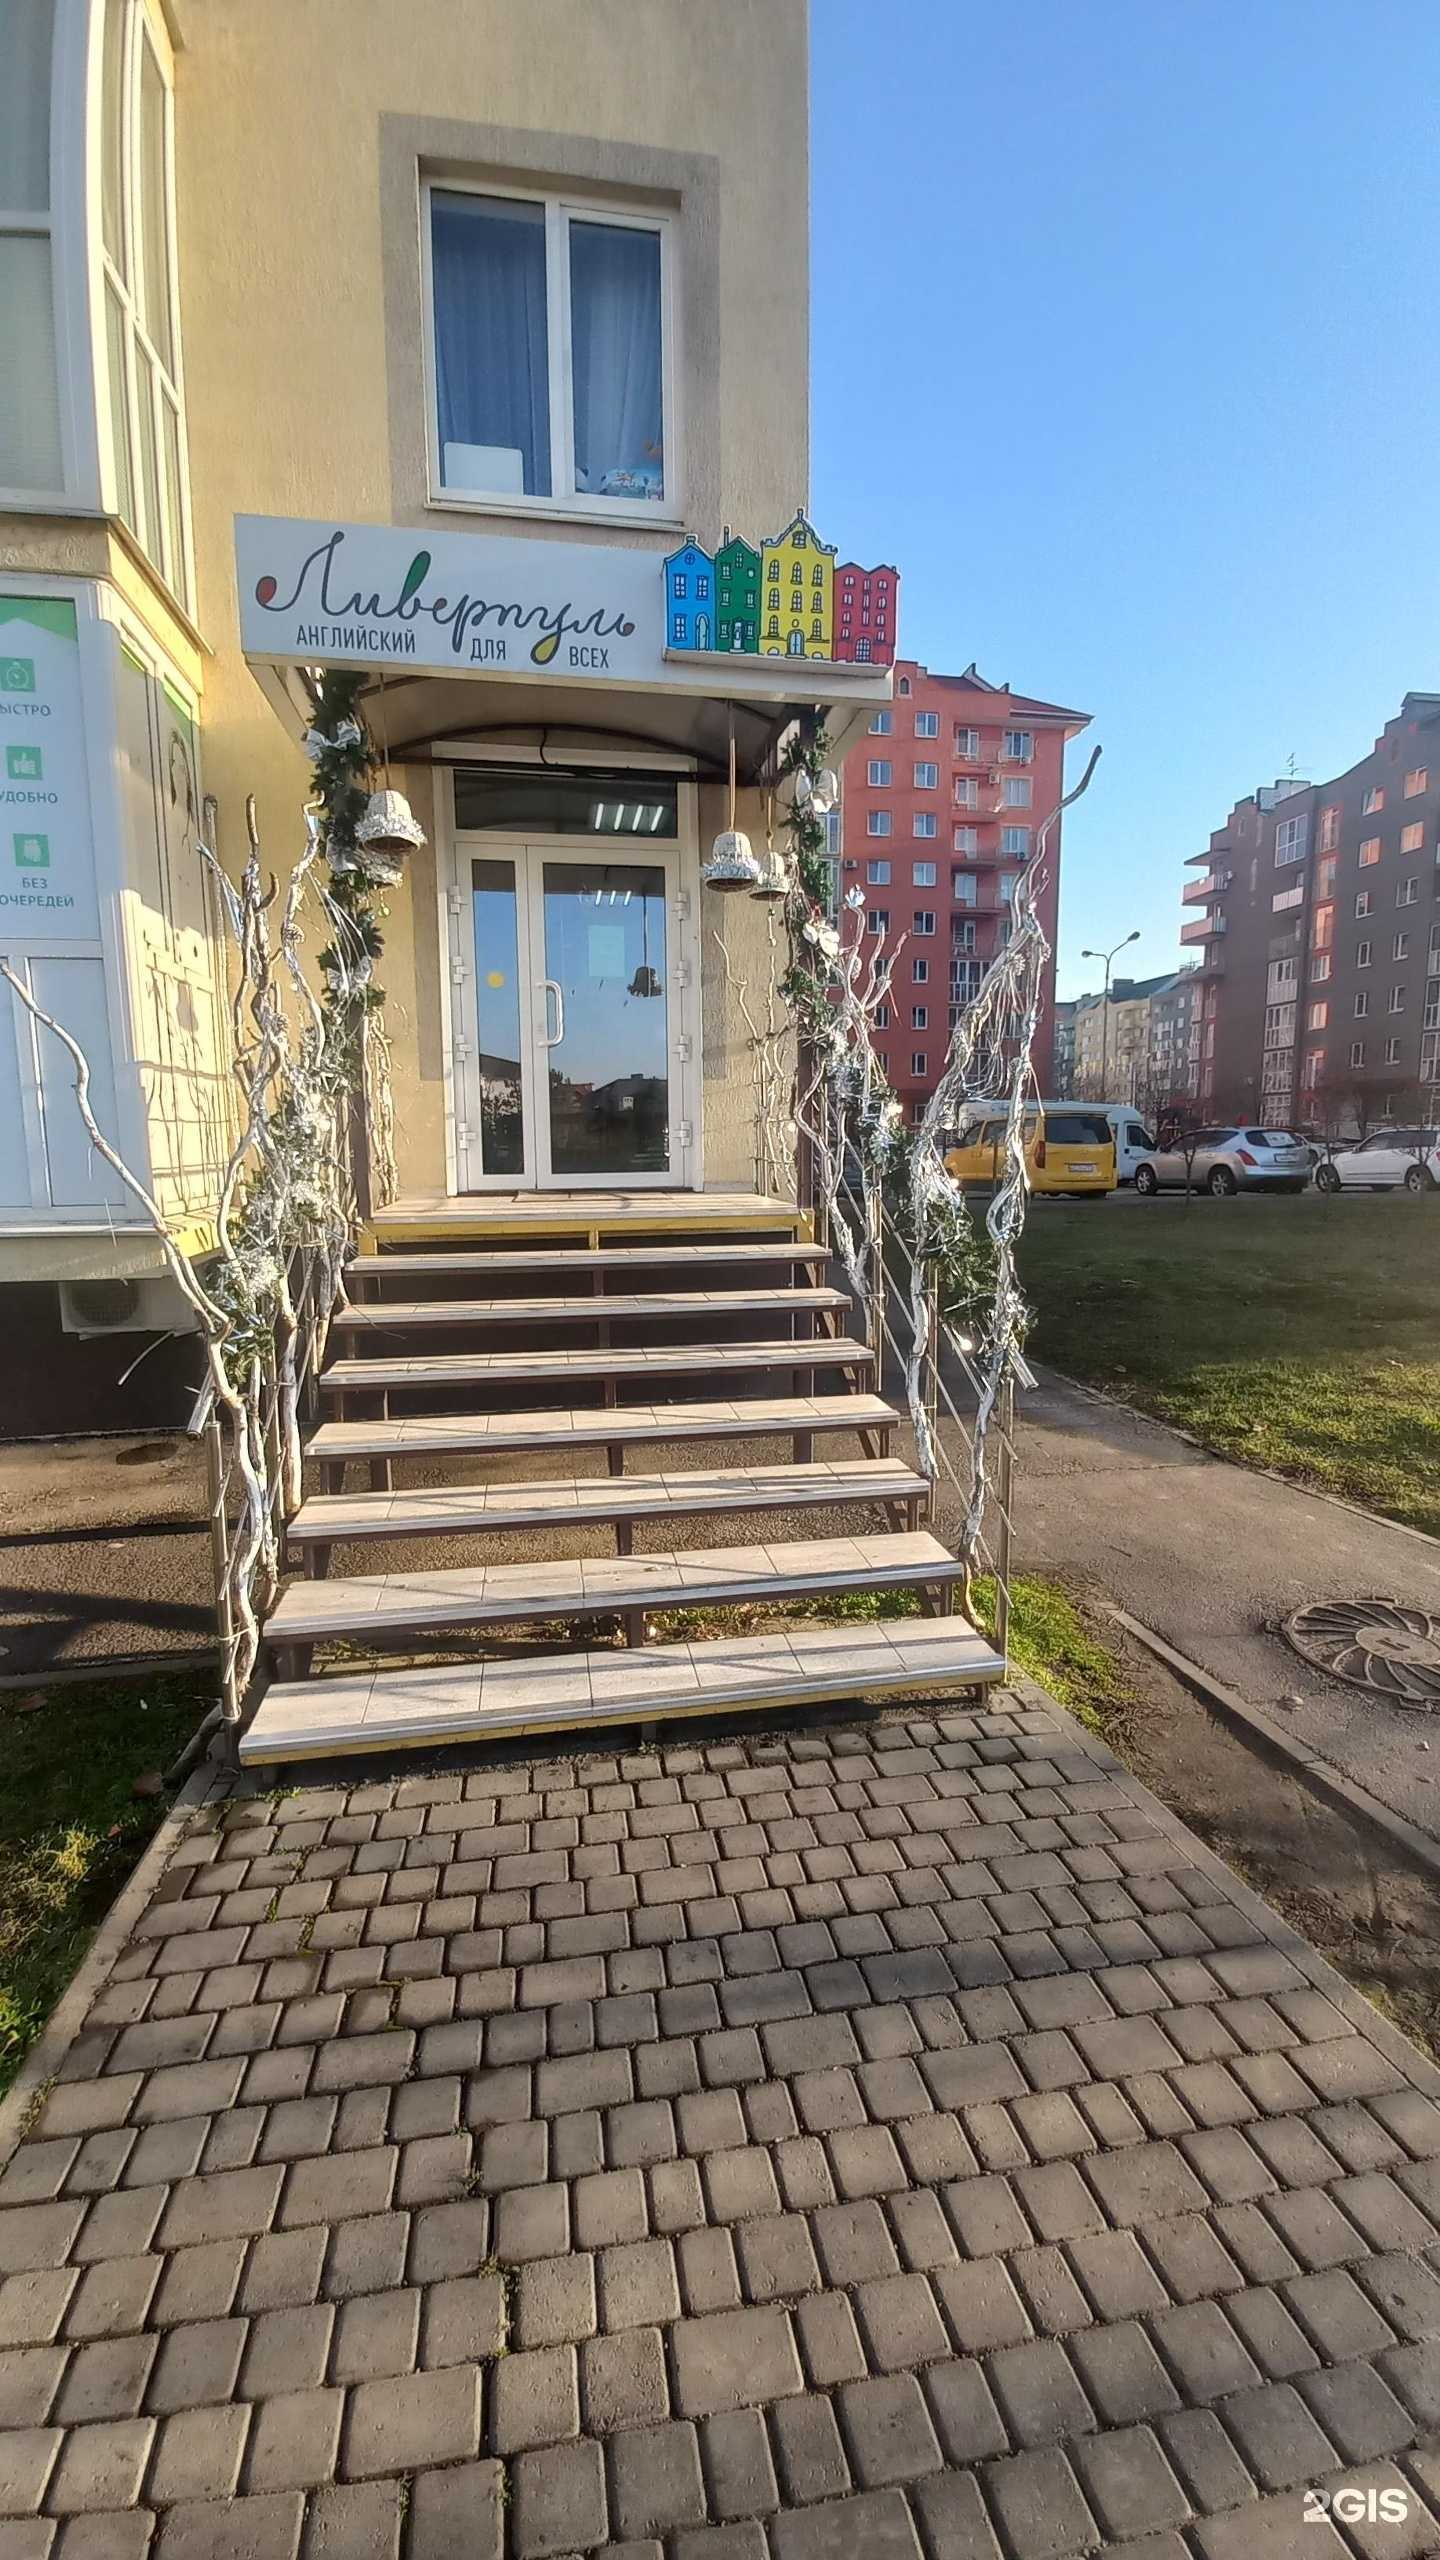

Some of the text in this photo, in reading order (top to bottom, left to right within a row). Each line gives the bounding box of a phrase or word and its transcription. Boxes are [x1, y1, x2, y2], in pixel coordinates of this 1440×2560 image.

[256, 531, 636, 665] Ливерпуль
[296, 625, 610, 669] АНГЛИЙСКИЙ ДЛЯ ВСЕХ
[0, 703, 51, 717] ЫСТРО
[22, 877, 48, 889] БЕЗ
[0, 893, 75, 908] ОЧЕРЕДЕЙ
